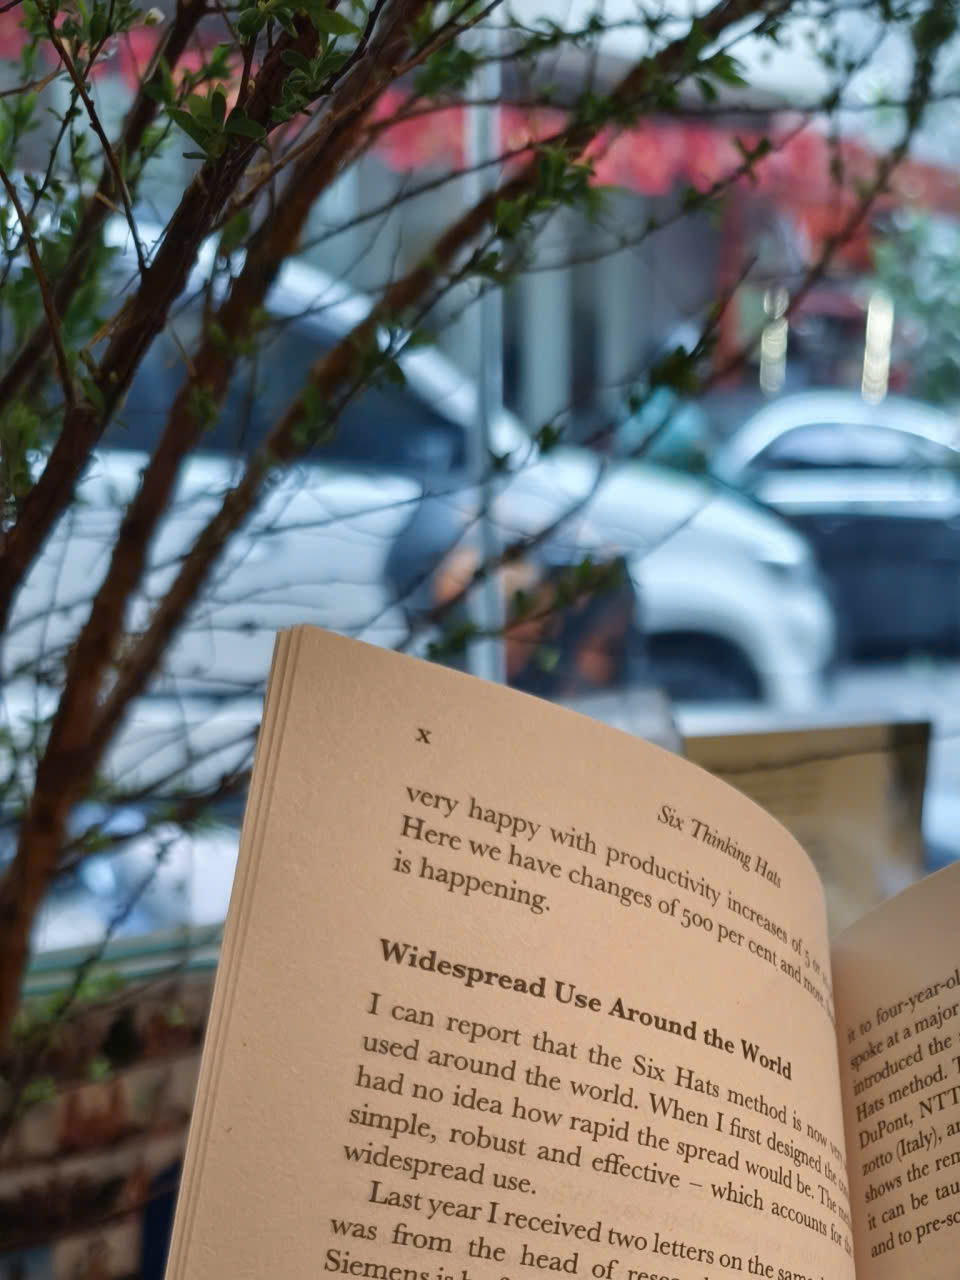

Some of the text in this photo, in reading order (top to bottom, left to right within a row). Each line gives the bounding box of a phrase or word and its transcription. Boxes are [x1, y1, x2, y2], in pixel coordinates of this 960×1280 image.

[416, 728, 431, 744] x
[394, 850, 549, 915] is happening.
[406, 786, 804, 957] very happy with productivity increases of
[657, 804, 782, 887] Six Thinking Hats
[400, 815, 802, 983] Here we have changes of 500 per cent and
[380, 938, 791, 1081] Widespread Use Around the World
[860, 1021, 871, 1035] to
[368, 992, 828, 1147] I can report that the Six Hats method is now
[858, 1113, 913, 1149] DuPont,
[918, 1085, 960, 1119] NTT
